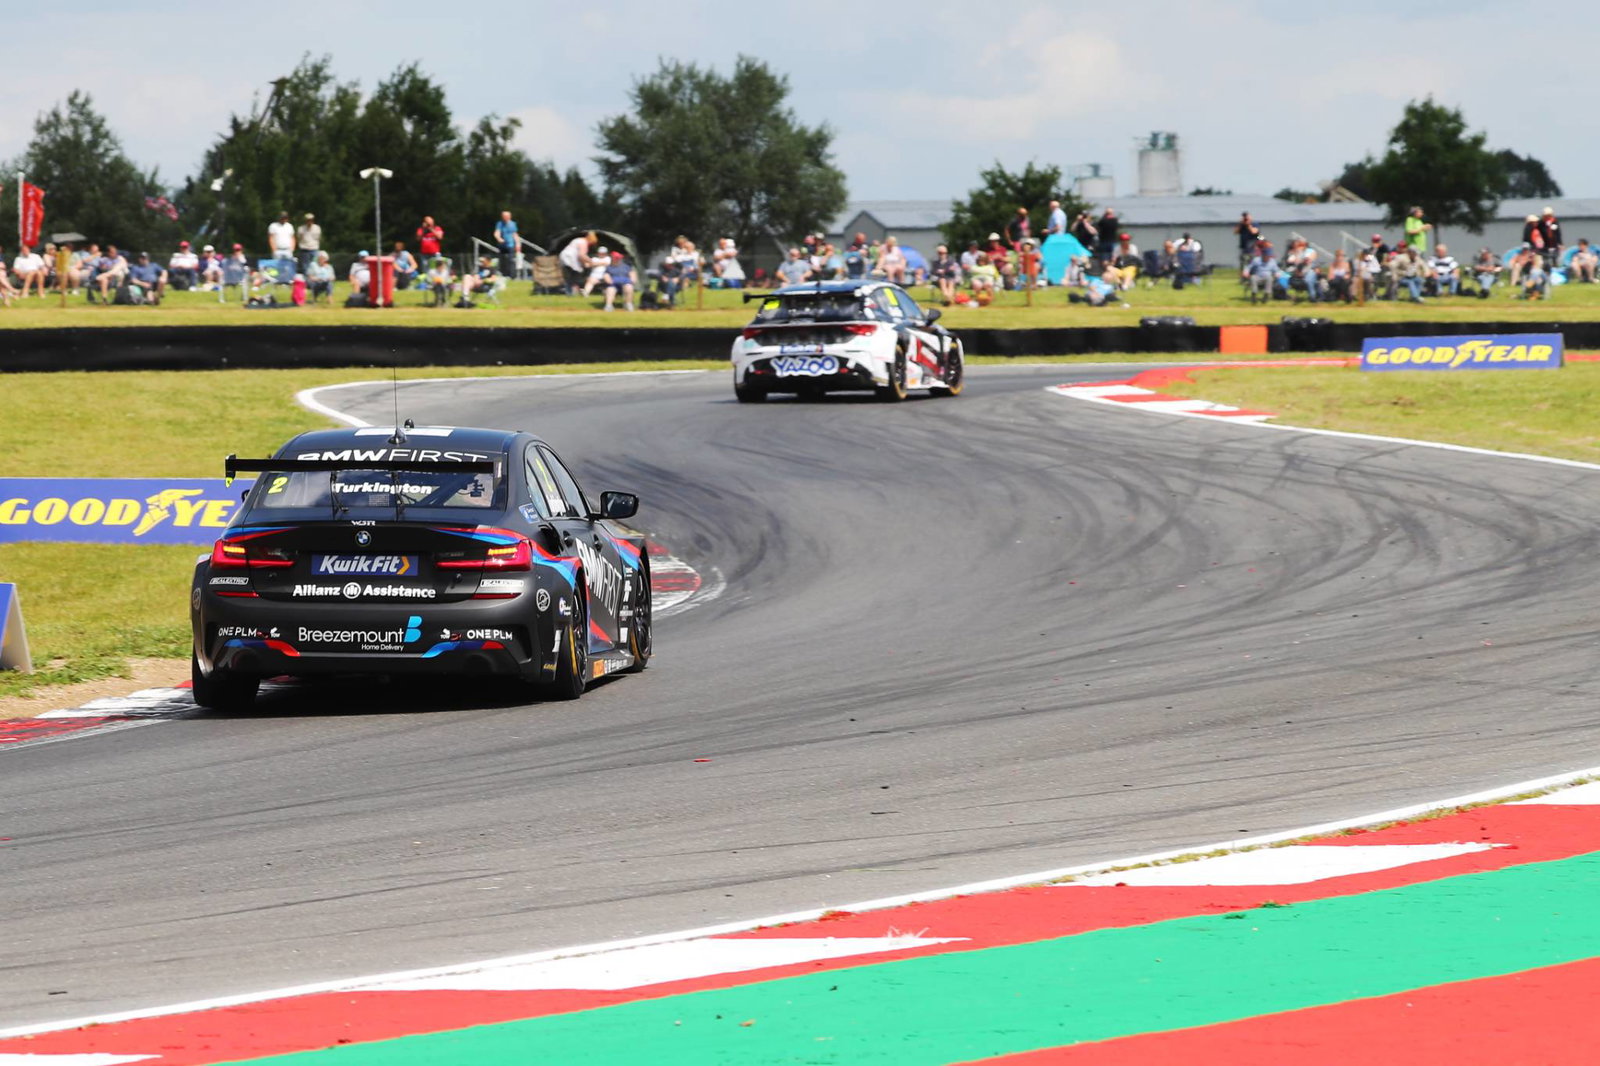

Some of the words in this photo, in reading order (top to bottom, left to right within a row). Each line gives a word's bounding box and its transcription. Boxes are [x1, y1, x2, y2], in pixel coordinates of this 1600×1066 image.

[1366, 344, 1552, 365] GOODYEAR
[773, 356, 836, 376] YAZOO
[268, 477, 288, 494] 2
[332, 482, 432, 495] Turkington
[0, 496, 238, 529] GOODYE
[292, 584, 341, 597] Allianz
[362, 584, 436, 598] Assistance
[235, 626, 257, 637] PLM
[298, 627, 405, 643] Breezemount
[467, 629, 491, 639] ONE
[493, 629, 513, 640] PLM
[381, 643, 404, 651] Delivery
